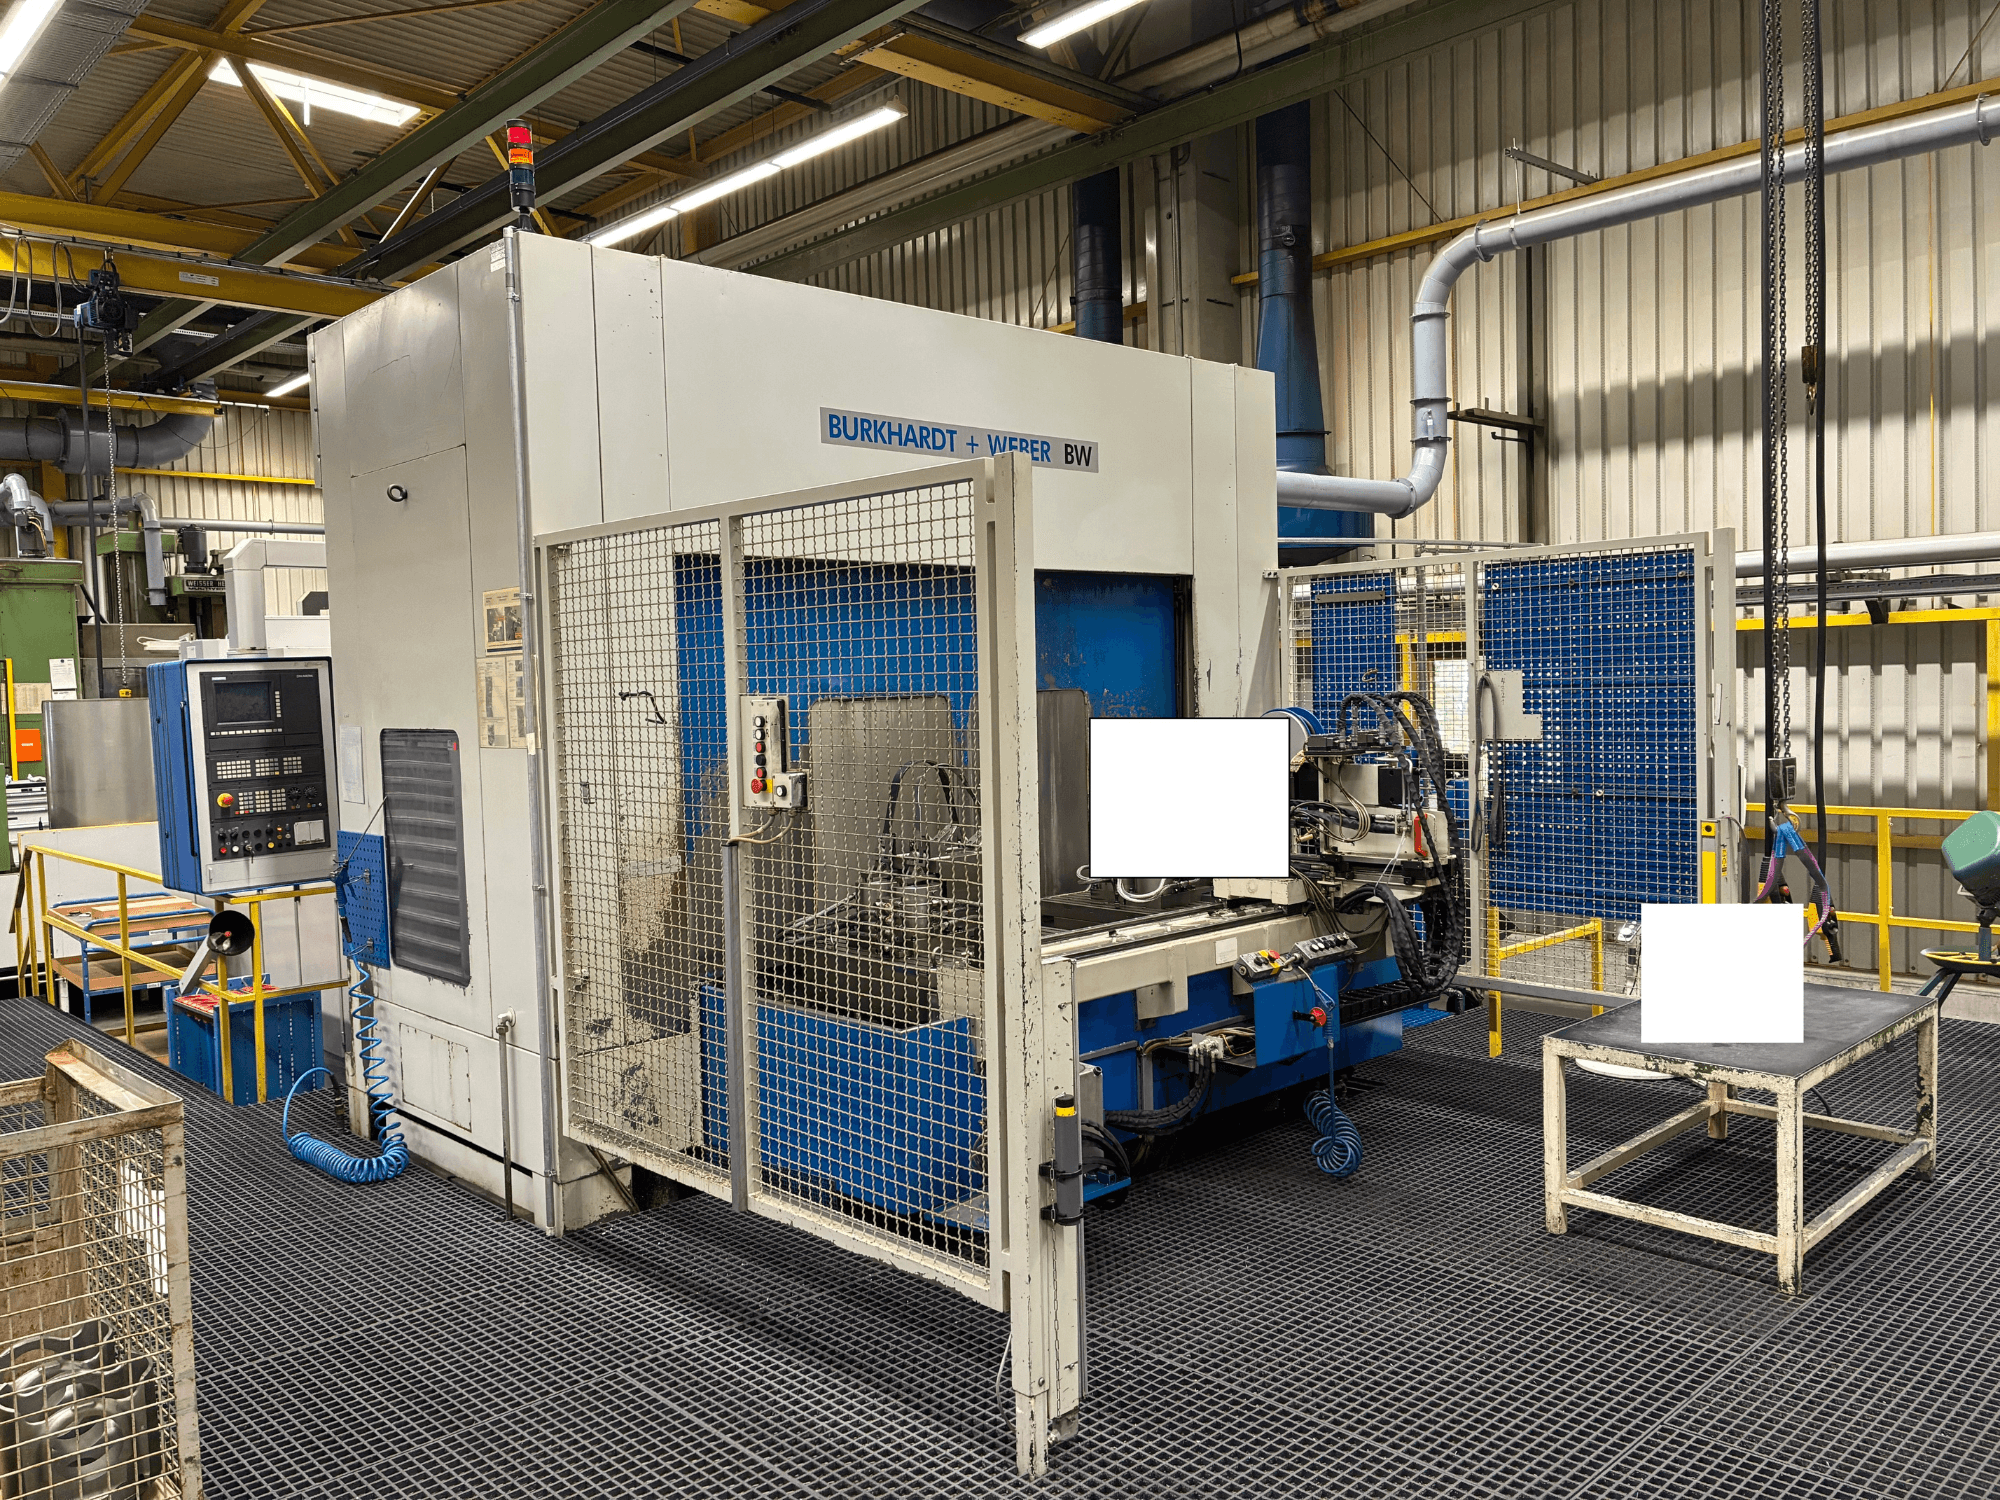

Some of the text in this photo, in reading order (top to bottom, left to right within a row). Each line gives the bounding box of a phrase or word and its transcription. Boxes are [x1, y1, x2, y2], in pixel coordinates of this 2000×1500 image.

[828, 413, 958, 453] BURKHARDT
[966, 435, 979, 454] +
[1064, 443, 1092, 467] BW
